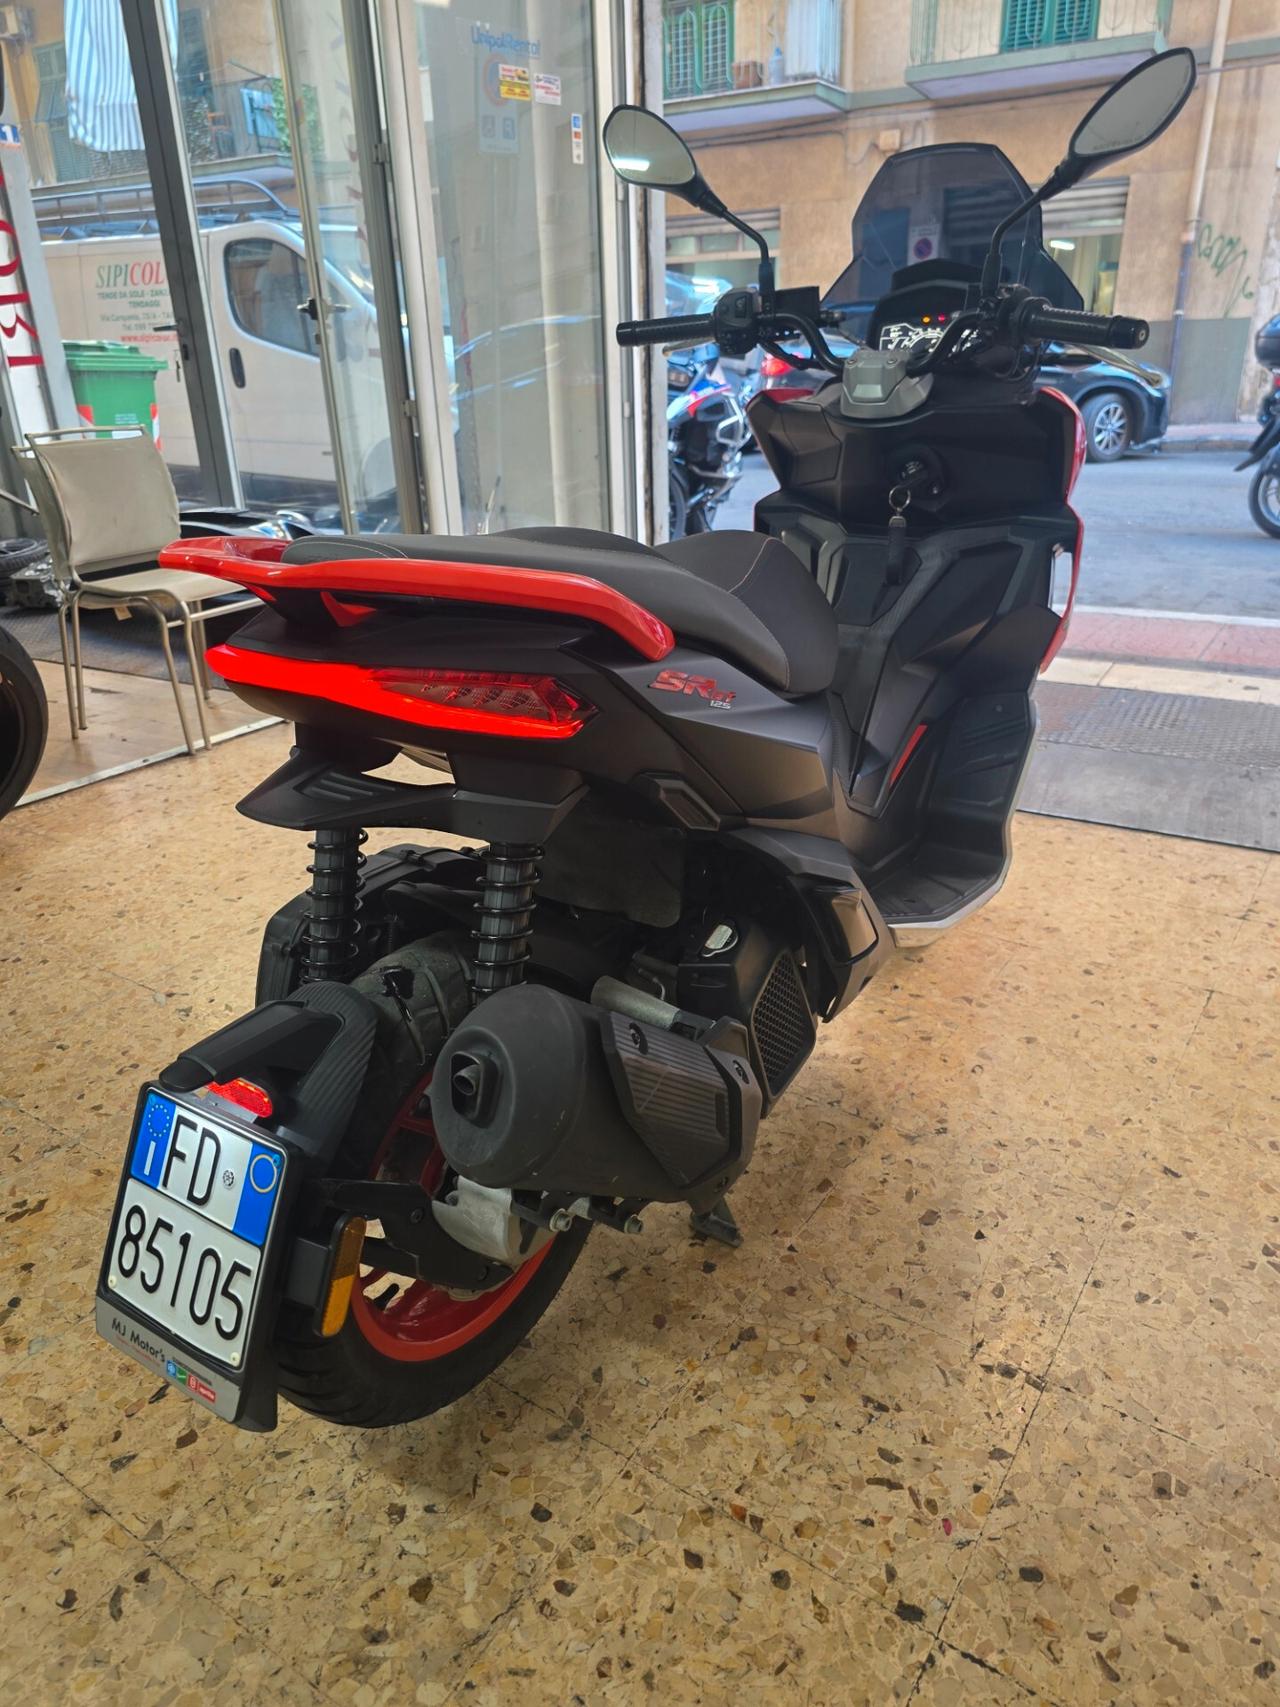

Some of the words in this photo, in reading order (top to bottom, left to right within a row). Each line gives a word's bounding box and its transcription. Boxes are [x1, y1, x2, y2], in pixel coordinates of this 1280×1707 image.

[96, 261, 166, 288] SIPICOL
[648, 670, 717, 700] SR
[710, 699, 732, 711] 125
[162, 1113, 222, 1206] FD
[117, 1204, 252, 1341] 85105
[111, 1317, 128, 1338] MJ
[129, 1329, 166, 1364] Motor's
